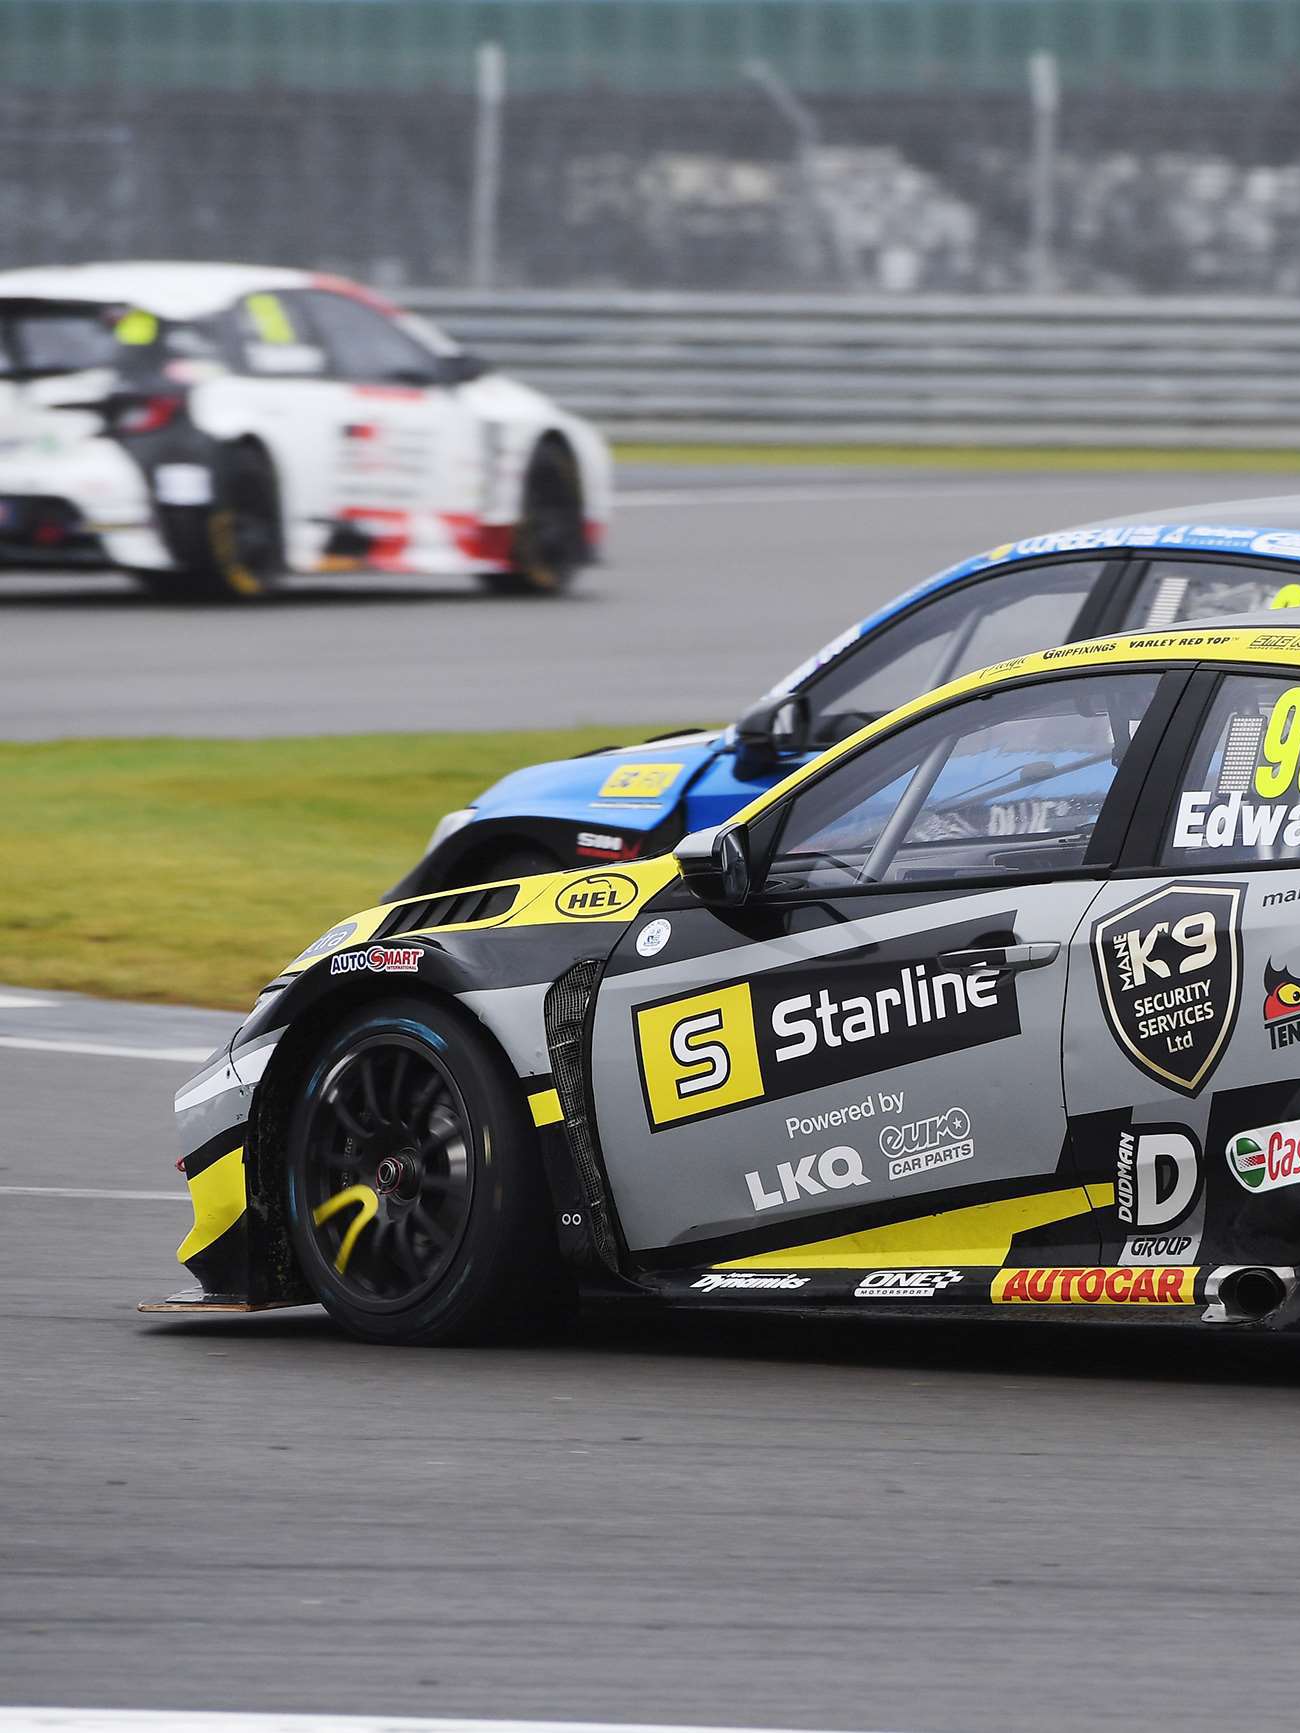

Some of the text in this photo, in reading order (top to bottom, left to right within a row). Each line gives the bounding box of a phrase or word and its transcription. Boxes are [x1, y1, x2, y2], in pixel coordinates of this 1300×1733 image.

[1043, 643, 1117, 660] GRIPFIXINGS
[1129, 636, 1231, 649] VARLEY RED TOP
[568, 890, 622, 909] HEL
[1113, 933, 1135, 992] MANE
[1127, 911, 1217, 987] K9
[772, 962, 1000, 1063] Starline
[1133, 979, 1212, 1018] SECURITY
[1138, 1001, 1214, 1039] SERVICES
[1167, 1032, 1193, 1054] Ltd
[785, 1091, 905, 1139] Powered by
[892, 1143, 972, 1176] CAR PARTS
[1118, 1132, 1135, 1223] DUDMAN
[744, 1145, 871, 1211] LKQ
[1137, 1133, 1198, 1227] D
[1131, 1236, 1192, 1258] GROUP
[690, 1274, 812, 1293] Dynamics
[859, 1271, 937, 1289] ONE
[1001, 1268, 1185, 1303] AUTOCAR
